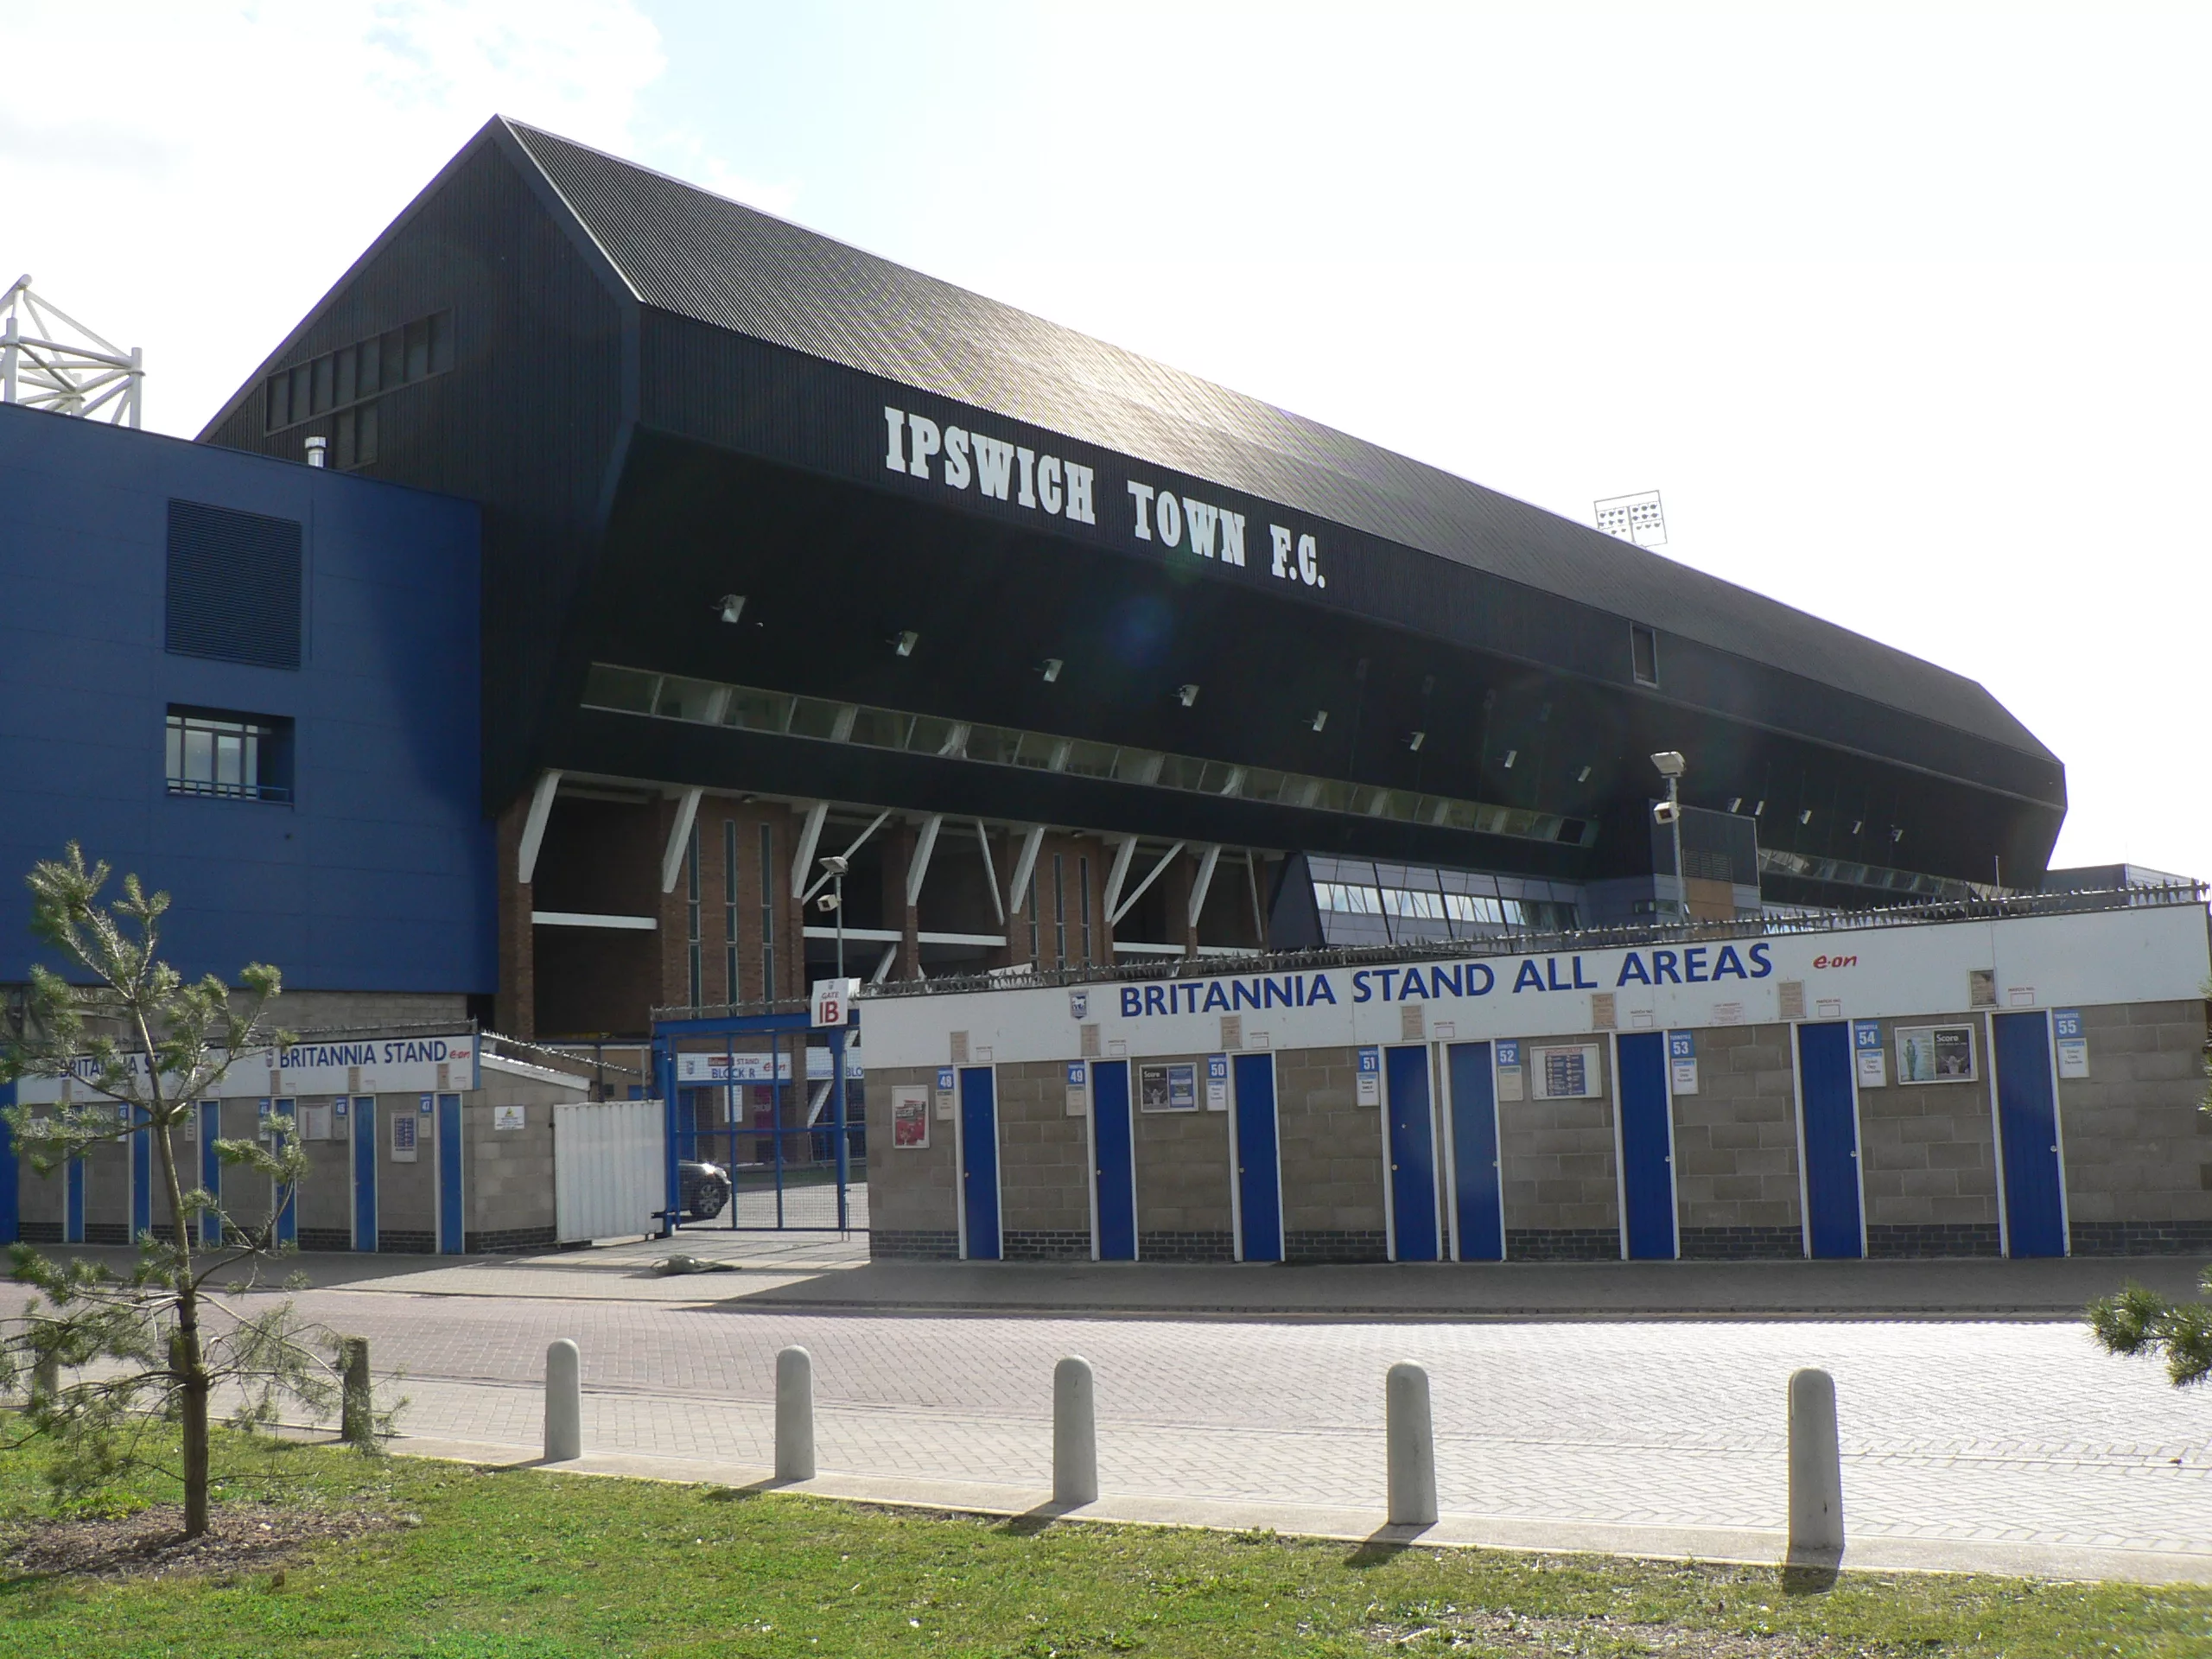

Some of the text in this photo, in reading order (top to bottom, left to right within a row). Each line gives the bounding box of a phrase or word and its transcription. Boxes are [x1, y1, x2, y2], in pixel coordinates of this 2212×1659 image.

[884, 406, 1096, 525] IPSWICH
[1127, 480, 1246, 567] TOWN
[1120, 943, 1772, 1017] BRITANNIA STAND ALL AREAS
[821, 991, 840, 1000] GATE
[2058, 1020, 2077, 1034] 55
[1859, 1031, 1875, 1046] 54
[1936, 1033, 1959, 1042] Score
[280, 1040, 448, 1068] BRITANNIA STAND
[1673, 1041, 1689, 1055] 53
[1499, 1050, 1515, 1063] 52
[1211, 1064, 1224, 1076] 50
[1363, 1057, 1376, 1070] 51
[940, 1076, 952, 1087] 48
[1070, 1070, 1084, 1083] 49
[422, 1101, 430, 1110] 47
